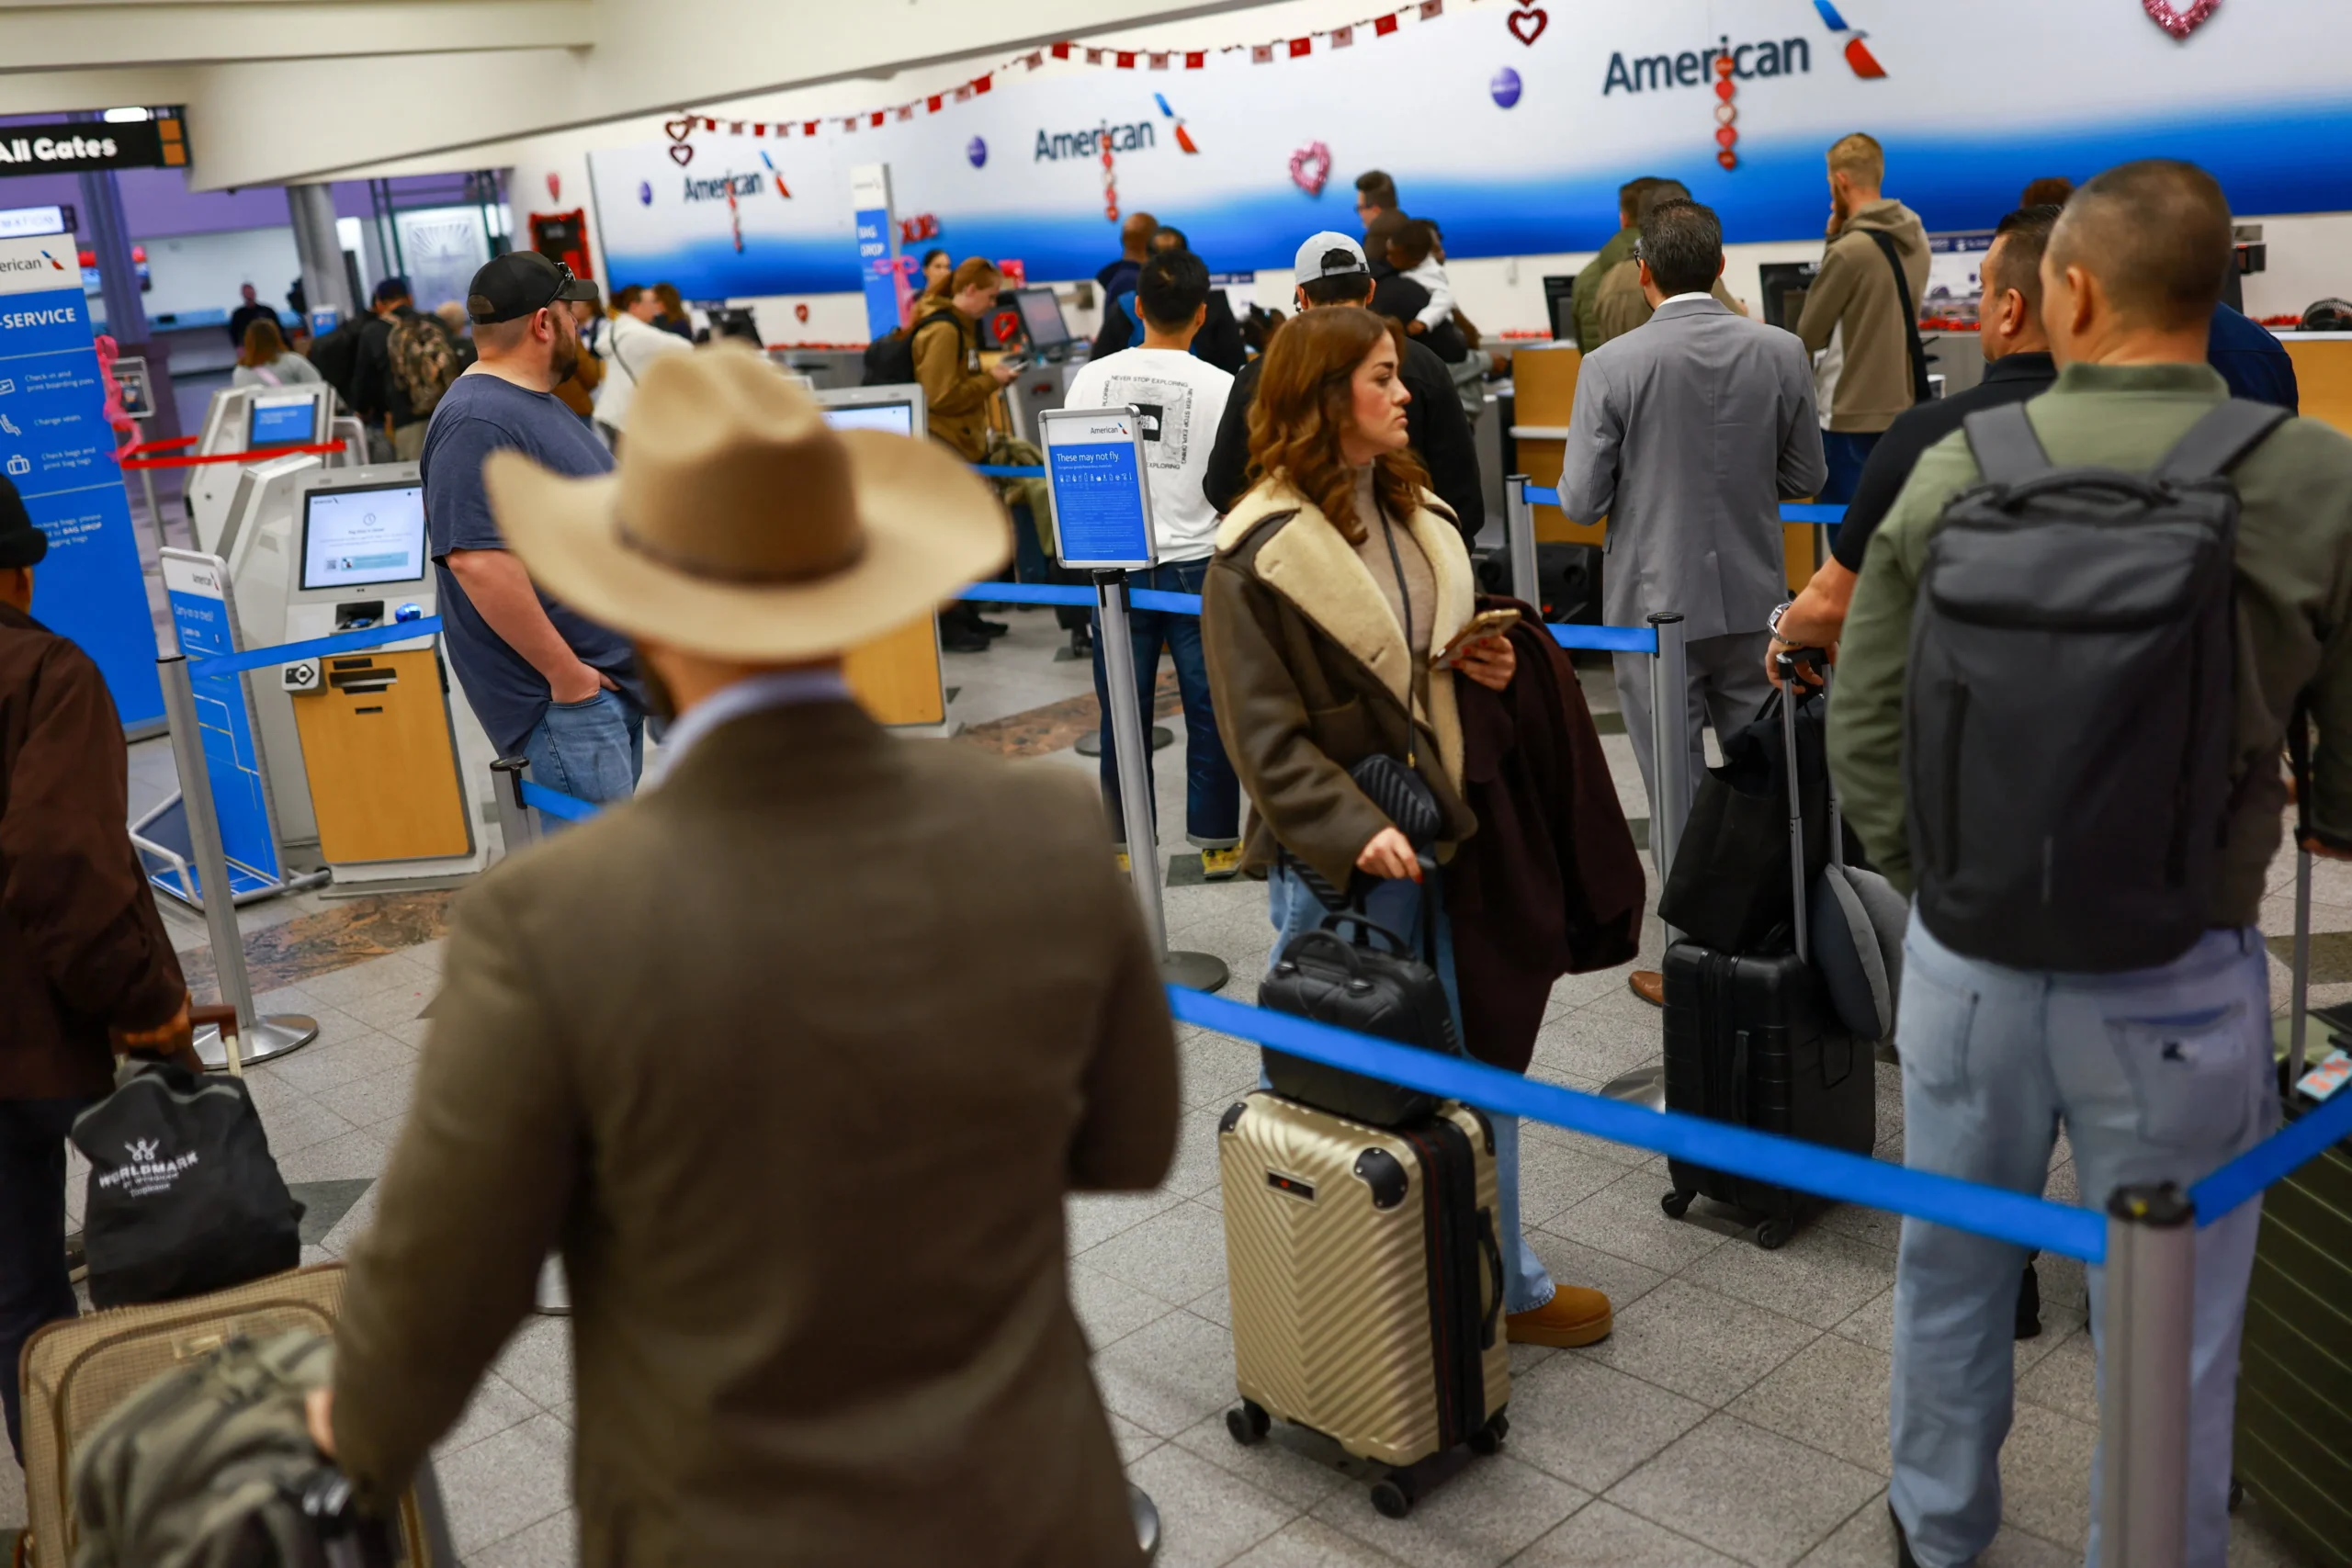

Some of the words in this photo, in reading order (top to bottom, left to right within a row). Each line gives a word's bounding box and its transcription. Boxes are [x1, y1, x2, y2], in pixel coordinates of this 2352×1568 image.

[1602, 35, 1811, 96] American
[33, 135, 118, 161] Gates
[1102, 380, 1110, 406] PLORING
[1151, 378, 1188, 388] EXPLORING
[1185, 388, 1193, 410] NEVER
[1091, 426, 1118, 434] American
[1182, 411, 1191, 428] STOP
[1057, 453, 1077, 462] These
[1079, 454, 1094, 463] may
[1095, 453, 1108, 461] not
[1109, 451, 1120, 463] fly.
[1181, 429, 1189, 465] EXPLORING
[99, 1150, 198, 1189] WORLDMARK
